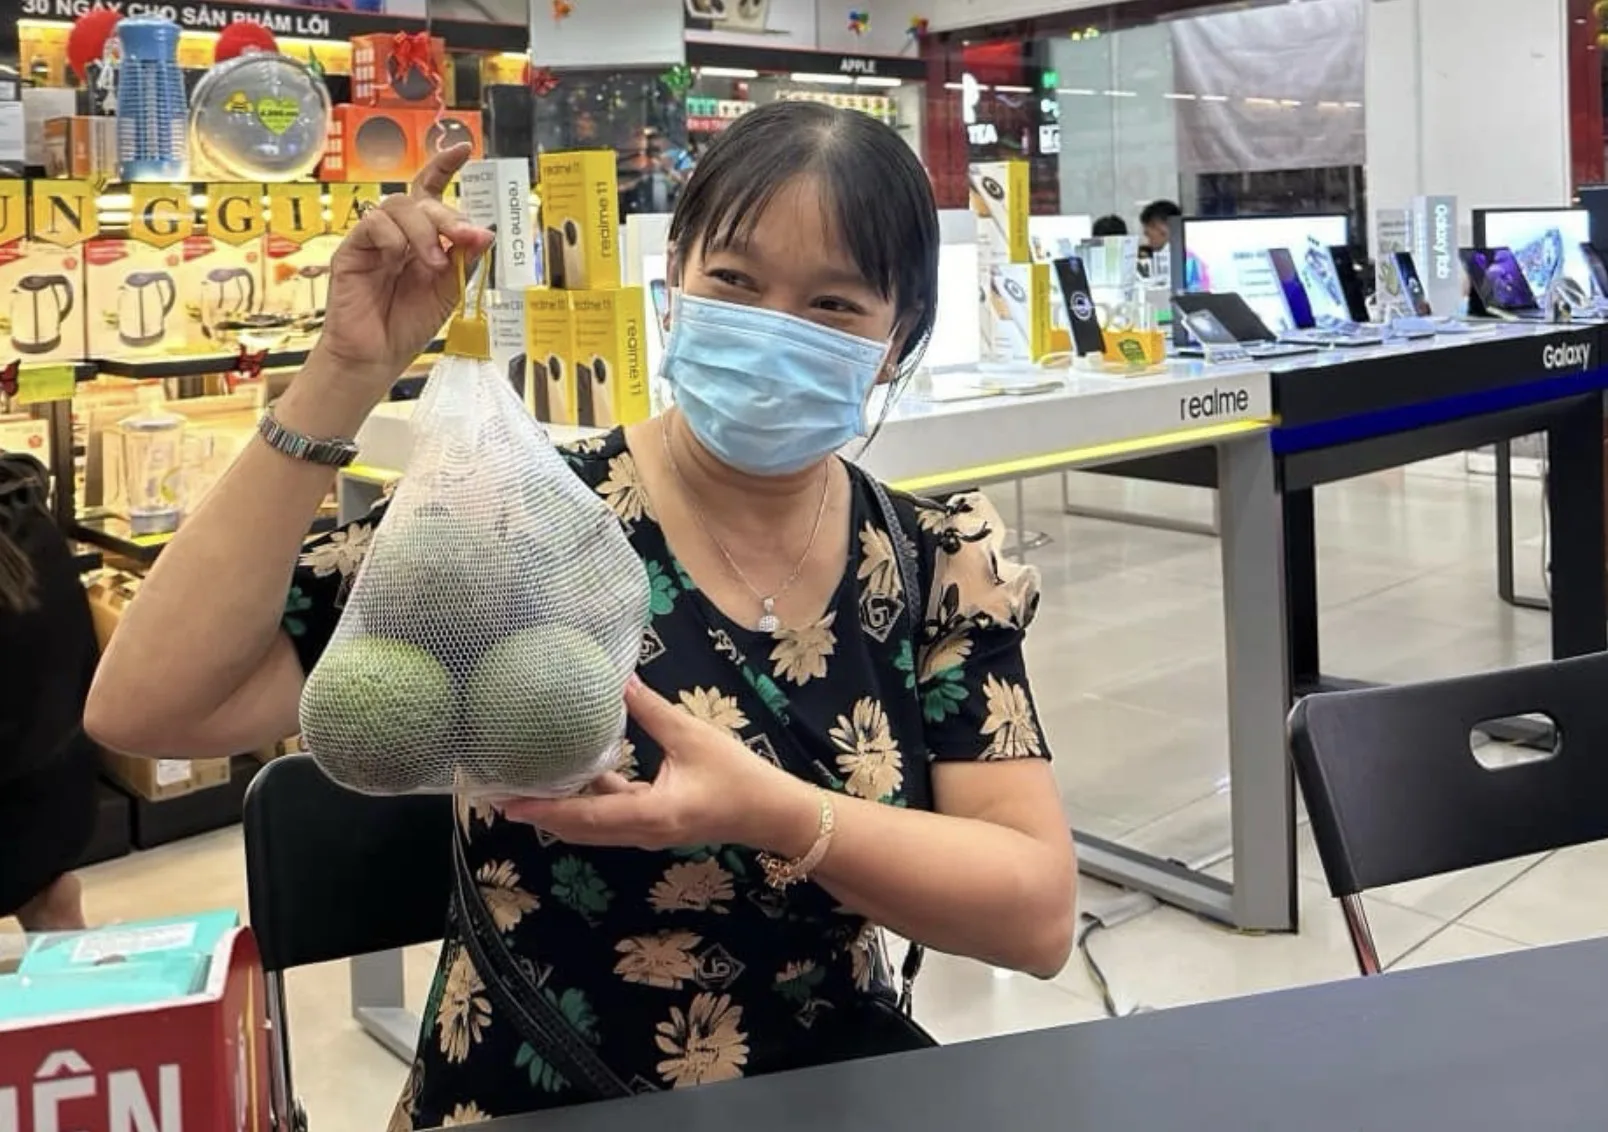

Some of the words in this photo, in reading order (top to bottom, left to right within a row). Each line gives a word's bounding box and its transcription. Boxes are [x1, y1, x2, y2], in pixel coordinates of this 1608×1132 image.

[22, 0, 49, 14] 30
[839, 58, 876, 74] APPLE
[595, 182, 608, 194] 11
[509, 181, 523, 235] realme
[597, 198, 612, 258] realme
[512, 239, 526, 267] C51
[627, 318, 641, 379] realme
[1542, 342, 1592, 373] Galaxy
[631, 382, 644, 396] 11
[1180, 386, 1249, 421] realme
